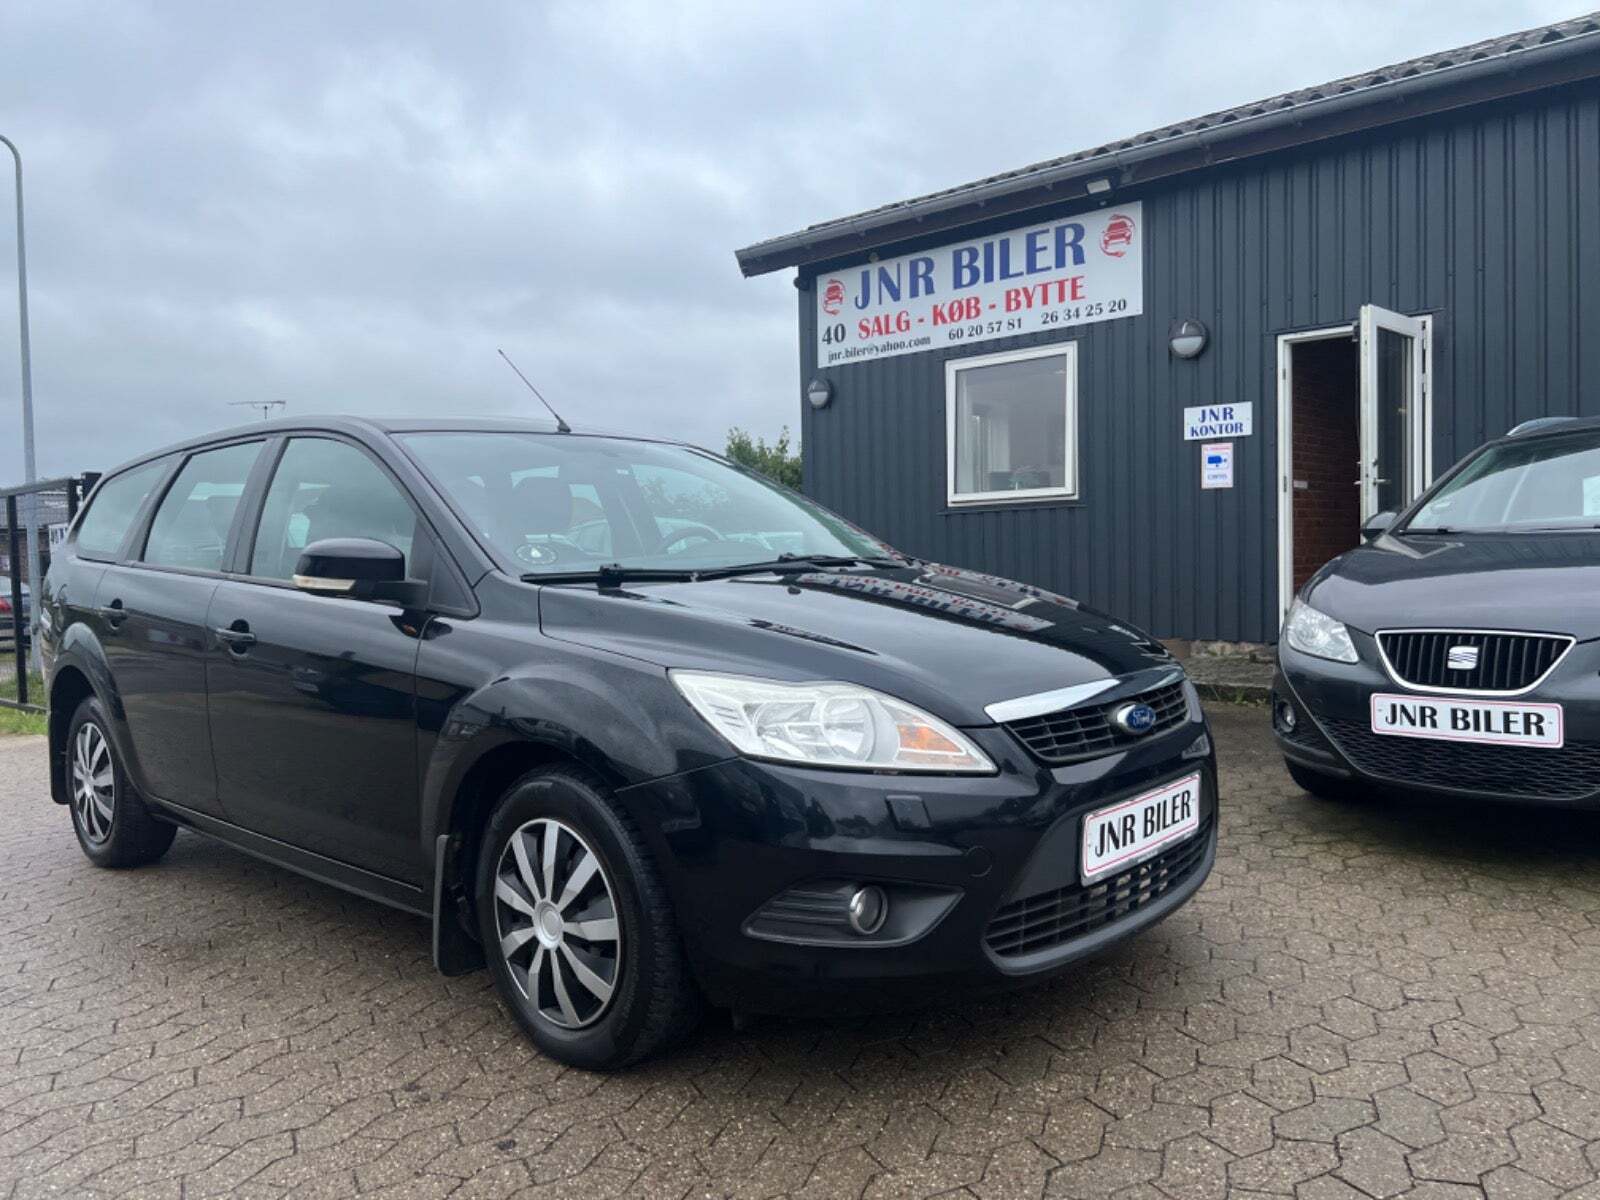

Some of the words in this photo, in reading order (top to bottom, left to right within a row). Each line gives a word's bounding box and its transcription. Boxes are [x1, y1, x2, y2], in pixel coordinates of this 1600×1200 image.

[854, 256, 936, 310] JNR
[953, 222, 1086, 291] BILER
[858, 310, 911, 340] SALG
[932, 295, 981, 326] KØB
[1005, 276, 1086, 313] BYTTE
[949, 328, 964, 341] 60
[968, 324, 983, 338] 20
[987, 320, 1003, 334] 57
[1007, 317, 1022, 330] 81
[1041, 311, 1058, 325] 26
[1063, 306, 1080, 321] 34
[1085, 302, 1103, 317] 25
[1108, 298, 1127, 313] 20
[822, 323, 847, 345] 40
[1190, 422, 1244, 437] KONTOR
[1198, 406, 1234, 423] JNR
[1385, 702, 1438, 729] JNR
[1450, 707, 1546, 737] BILER
[1095, 813, 1136, 858] JNR
[1143, 789, 1191, 839] BILER
